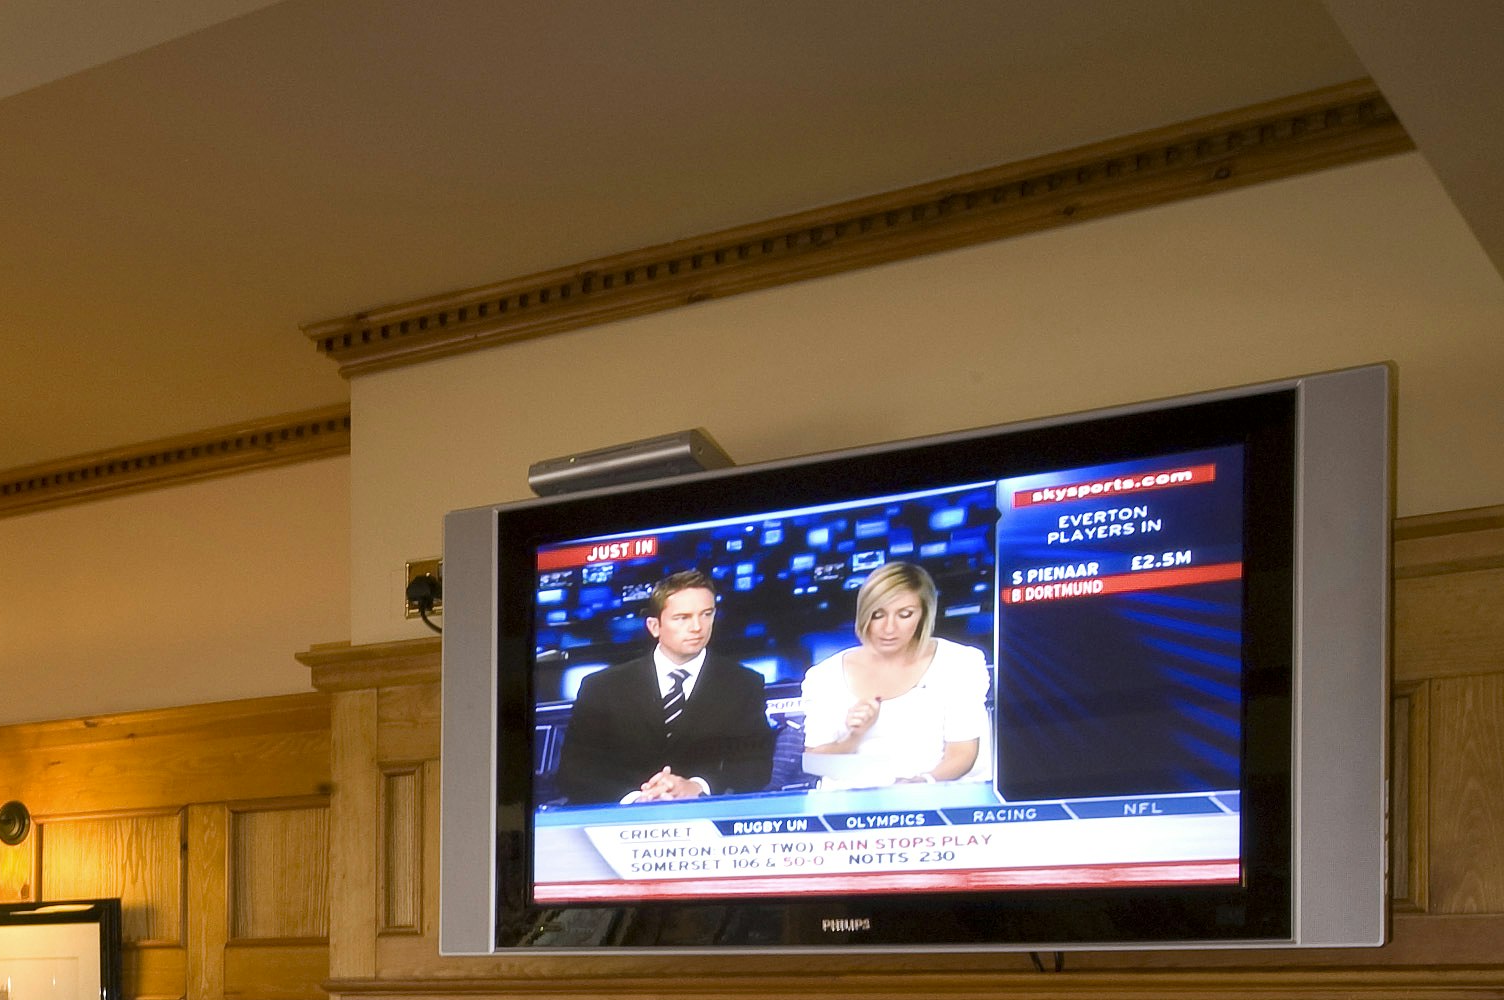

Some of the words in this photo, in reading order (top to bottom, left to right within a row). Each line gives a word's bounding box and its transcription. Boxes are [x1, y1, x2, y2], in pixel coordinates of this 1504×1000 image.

[1032, 470, 1193, 502] skysports.com
[1058, 506, 1148, 529] EVERTON
[1047, 522, 1135, 545] PLAYERS
[1141, 519, 1162, 534] IN
[587, 542, 629, 561] JUST
[635, 539, 653, 555] IN
[1012, 570, 1023, 585] S
[1027, 562, 1100, 583] PIENAAR
[1130, 550, 1192, 571] £2.5M
[1011, 588, 1022, 603] B
[1025, 579, 1104, 602] DORTMUND
[973, 808, 1038, 823] RACING
[1123, 803, 1164, 815] NFL
[733, 820, 783, 835] RUGBY
[786, 819, 808, 832] UN
[846, 813, 926, 829] OLYMPICS
[619, 827, 693, 841] CRICKET
[722, 844, 763, 856] (DAY
[772, 842, 814, 854] TWO)
[824, 839, 868, 852] RAIN
[875, 836, 936, 849] STOPS
[942, 833, 993, 847] PLAY
[631, 859, 721, 873] SOMERSET
[732, 857, 760, 869] 106
[766, 857, 777, 868] &
[849, 852, 909, 865] NOTTS
[920, 850, 956, 863] 230
[822, 918, 870, 933] PHILIPS
